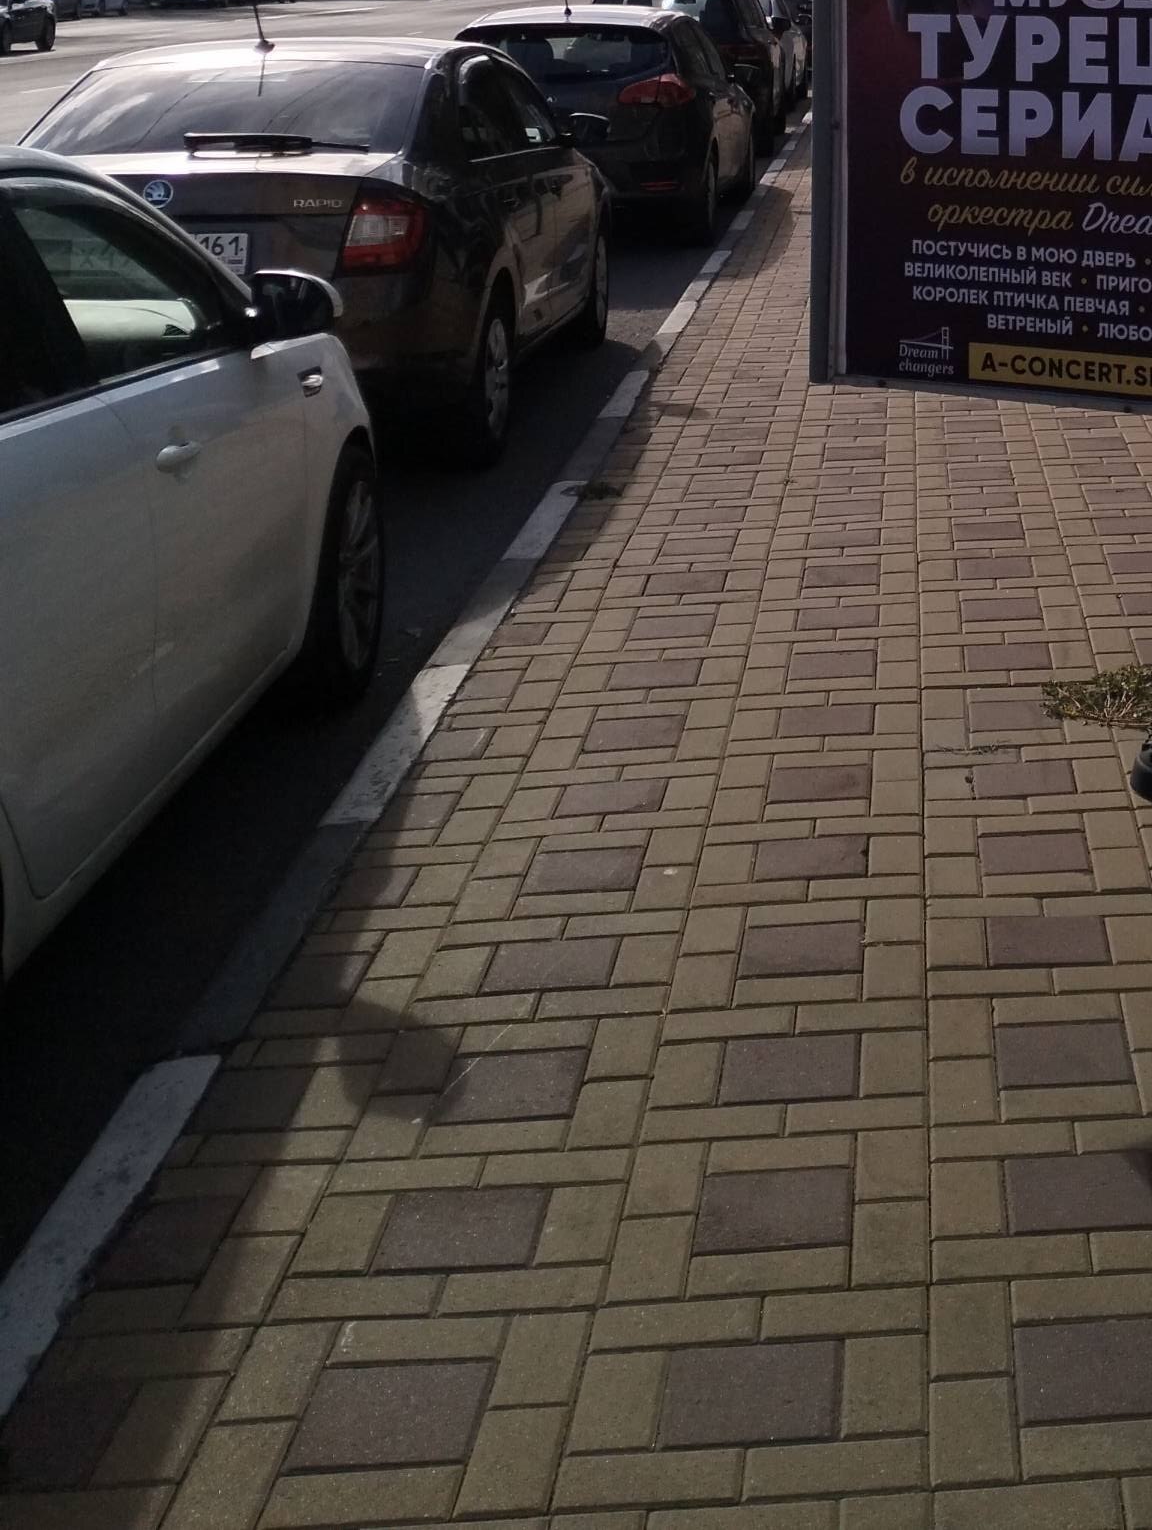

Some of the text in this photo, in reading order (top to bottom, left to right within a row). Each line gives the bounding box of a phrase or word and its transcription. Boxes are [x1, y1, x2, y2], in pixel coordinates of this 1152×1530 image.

[901, 156, 918, 184] в
[924, 165, 1101, 192] исполнении
[293, 198, 343, 209] RAPID
[928, 203, 1074, 236] оркестра
[912, 239, 1012, 260] ПОСТУЧИСЬ
[1016, 246, 1027, 260] В
[1031, 247, 1077, 264] МОЮ
[1081, 250, 1135, 268] ДВЕРЬ
[904, 261, 1037, 285] ВЕЛИКОЛЕПНЫЙ
[1042, 272, 1073, 288] ВЕК
[912, 285, 989, 306] КОРОЛЕК
[994, 291, 1060, 311] ПТИЧКА
[1064, 296, 1130, 317] ПЕВЧАЯ
[987, 313, 1074, 336] ВЕТРЕНЫЙ
[899, 344, 939, 360] Dream
[899, 359, 955, 378] changers
